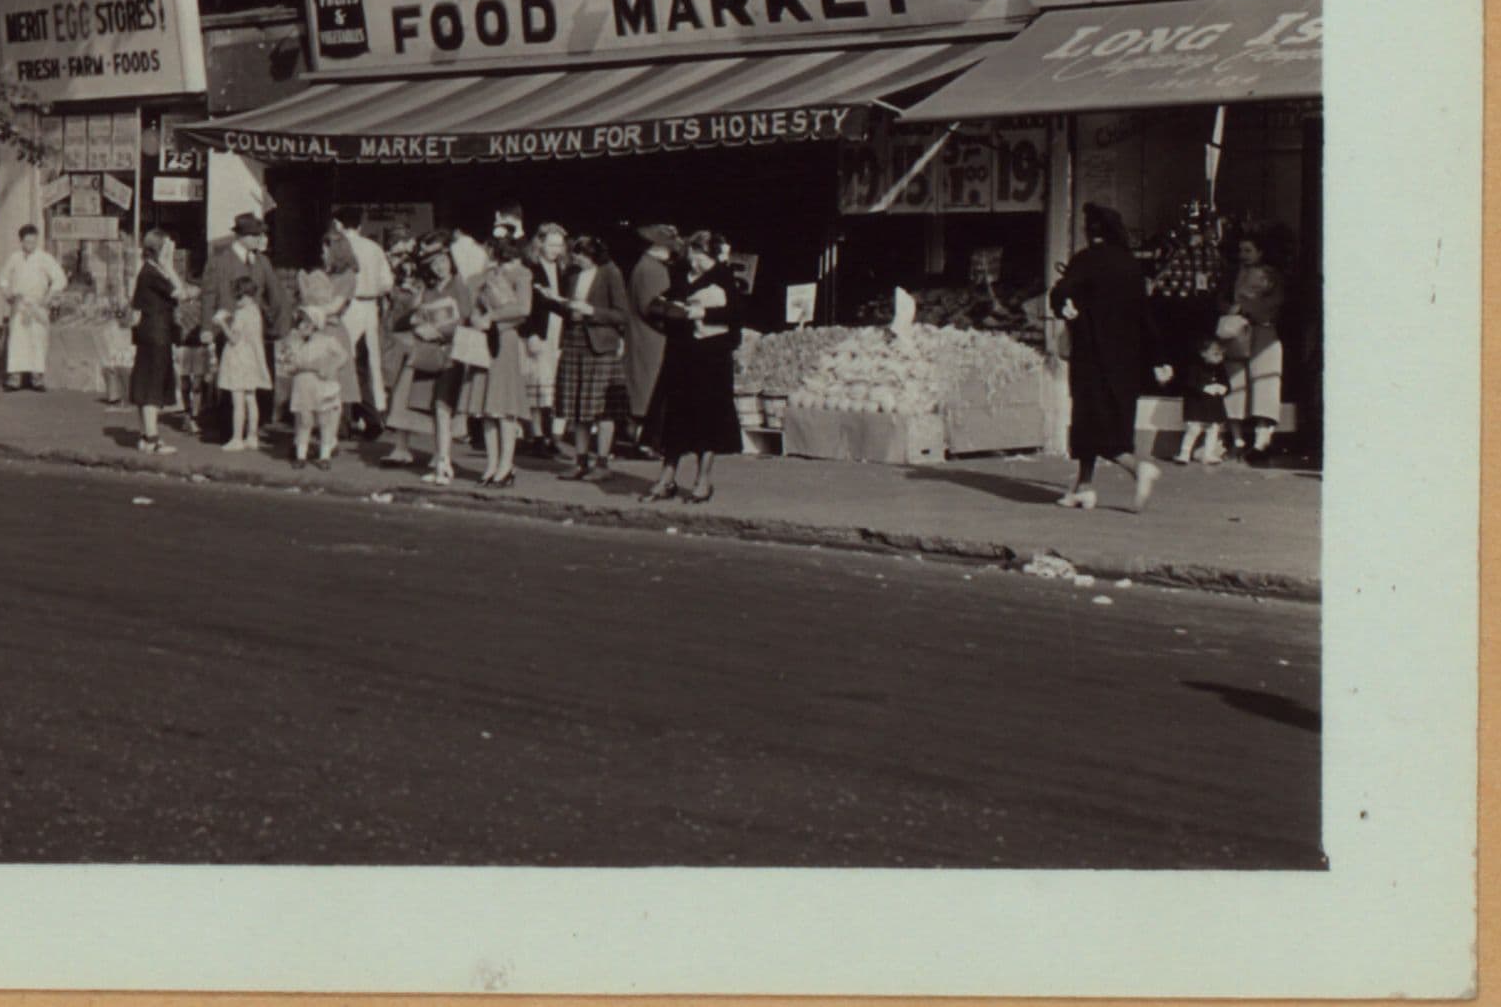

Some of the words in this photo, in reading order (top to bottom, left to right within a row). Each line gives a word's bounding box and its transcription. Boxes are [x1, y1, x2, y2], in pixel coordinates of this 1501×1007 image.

[6, 9, 49, 43] MERIT
[53, 0, 90, 42] EGG
[334, 8, 347, 25] &
[1042, 21, 1233, 60] LONG
[17, 57, 60, 81] FRESH
[113, 50, 161, 75] FOODS
[359, 136, 459, 157] MARKET
[489, 130, 583, 155] KNOWN
[593, 124, 644, 149] FOR
[653, 118, 702, 144] ITS
[711, 107, 851, 139] HONESTY
